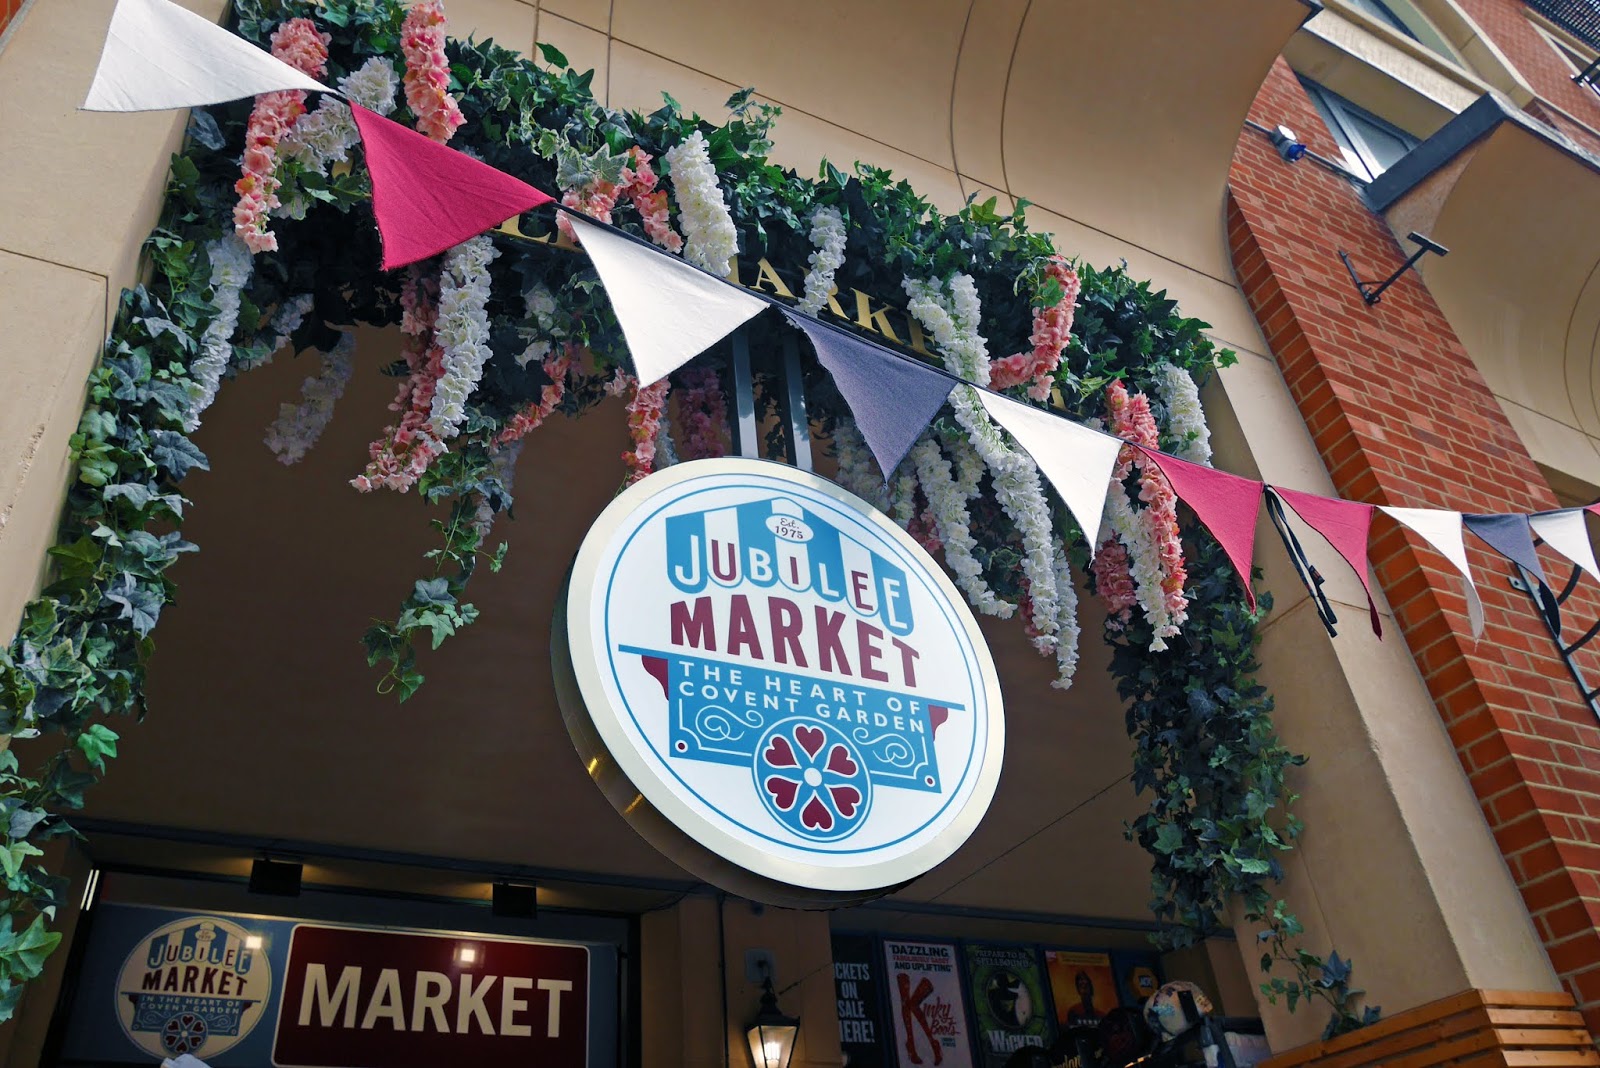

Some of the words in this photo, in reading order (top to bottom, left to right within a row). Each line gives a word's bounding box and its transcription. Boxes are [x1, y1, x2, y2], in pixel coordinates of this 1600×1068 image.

[775, 525, 804, 540] 1975
[779, 517, 800, 529] Est.
[674, 534, 909, 630] JUBILEE
[669, 594, 921, 689] MARKET
[679, 660, 743, 686] THE
[765, 667, 867, 706] HEART
[889, 697, 922, 717] OF
[678, 680, 799, 714] COVENT
[816, 702, 925, 735] GARDEN
[149, 943, 251, 973] JUBILEE
[894, 961, 910, 970] AND
[142, 965, 248, 996] MARKET
[834, 962, 870, 981] CKETS
[841, 980, 858, 999] ON
[140, 1002, 187, 1013] COVENT
[193, 1005, 240, 1015] GARDEN
[186, 998, 221, 1007] HEART
[298, 962, 573, 1039] MARKET
[837, 999, 866, 1019] SALE
